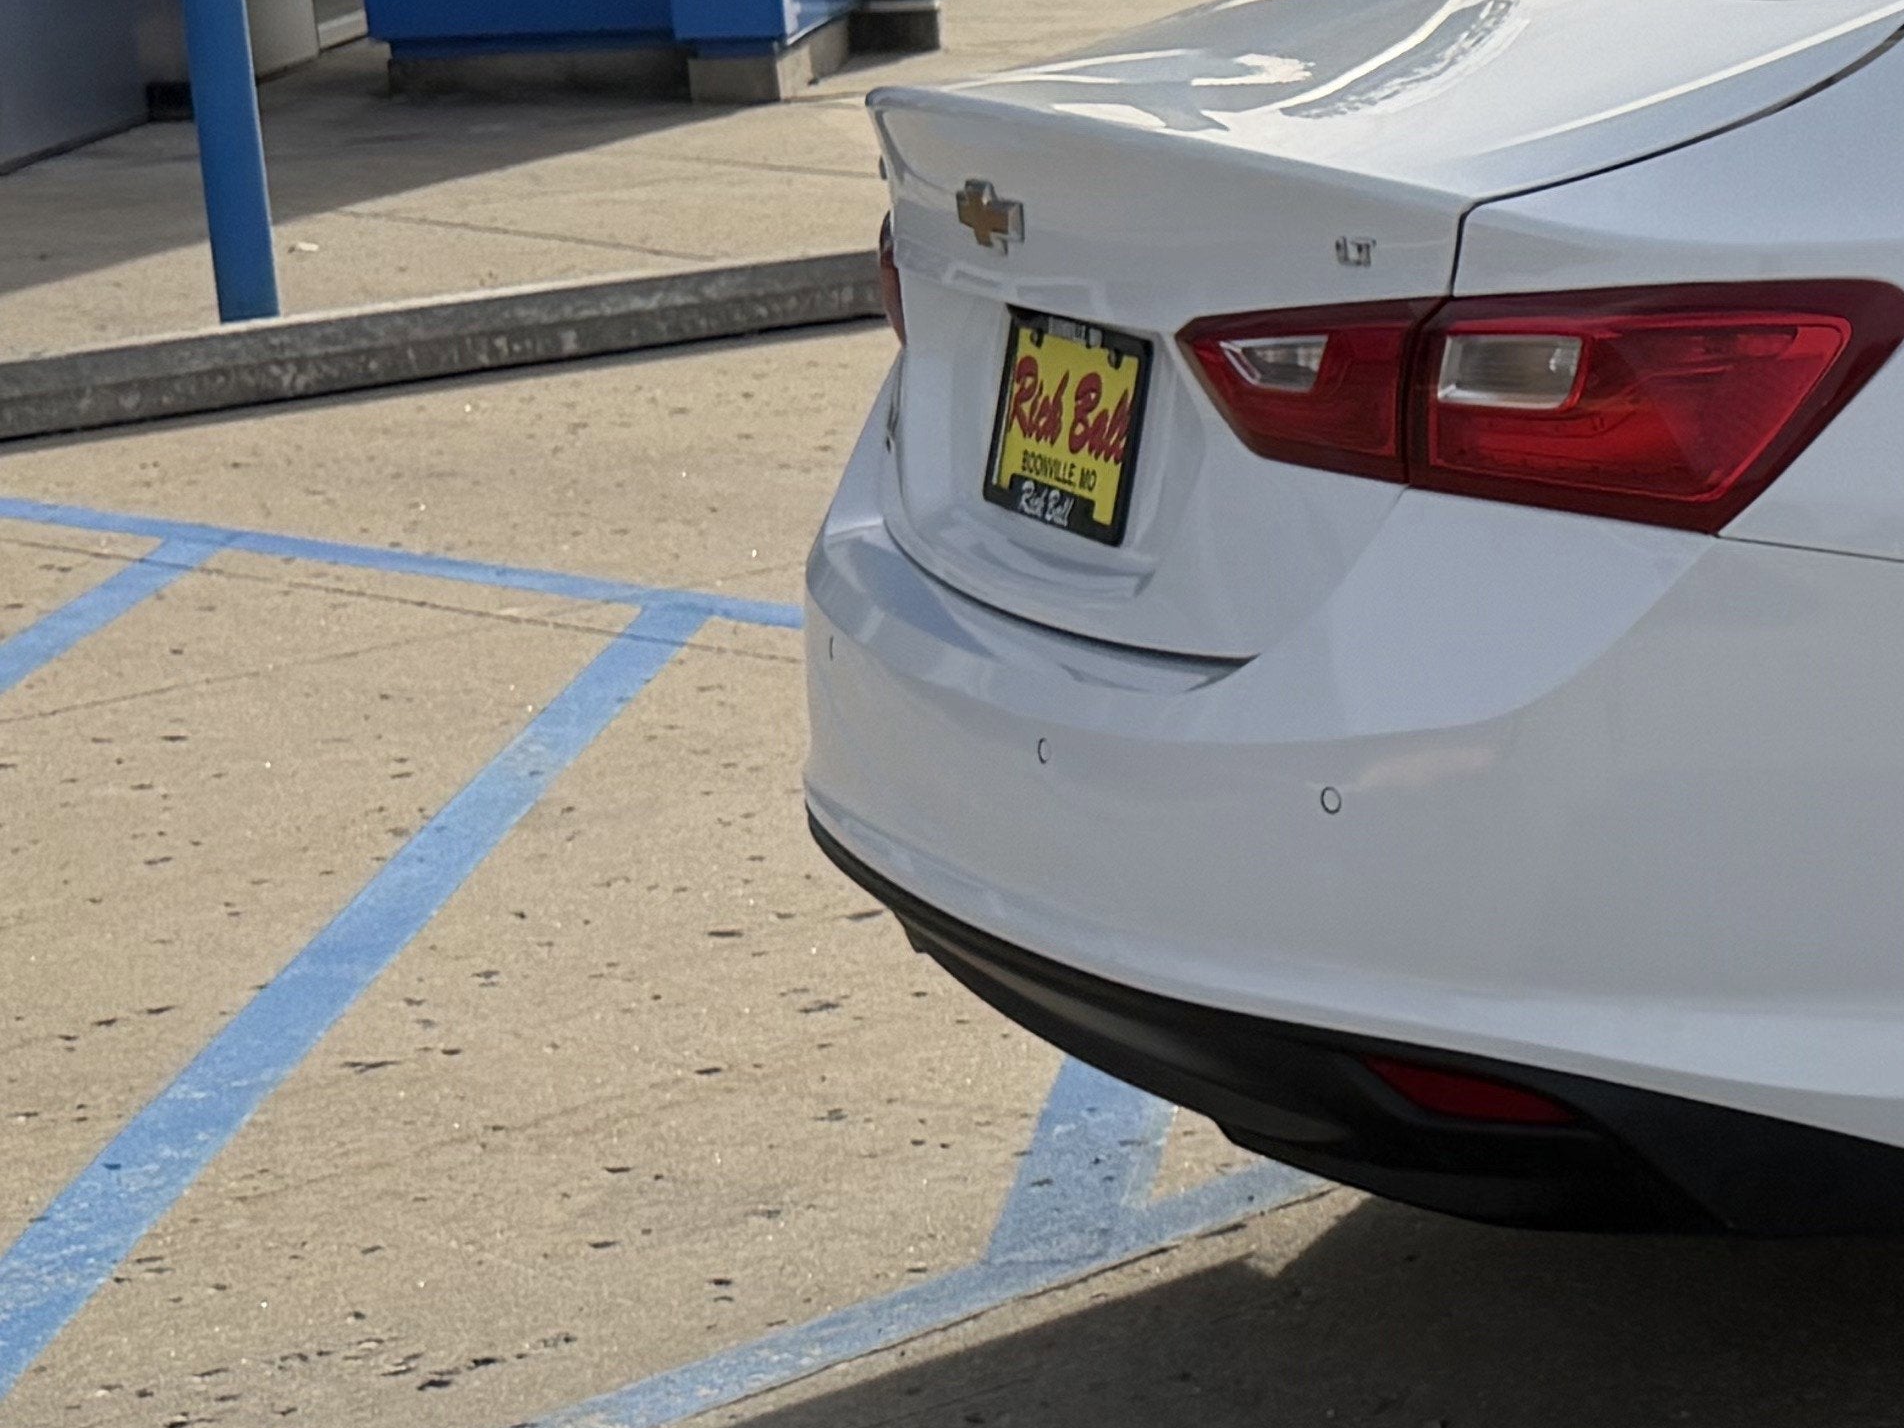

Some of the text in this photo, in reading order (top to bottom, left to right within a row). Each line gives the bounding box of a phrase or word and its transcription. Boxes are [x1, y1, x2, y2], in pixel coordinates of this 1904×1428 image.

[1009, 355, 1133, 465] Rick Ball
[1078, 462, 1097, 492] MO
